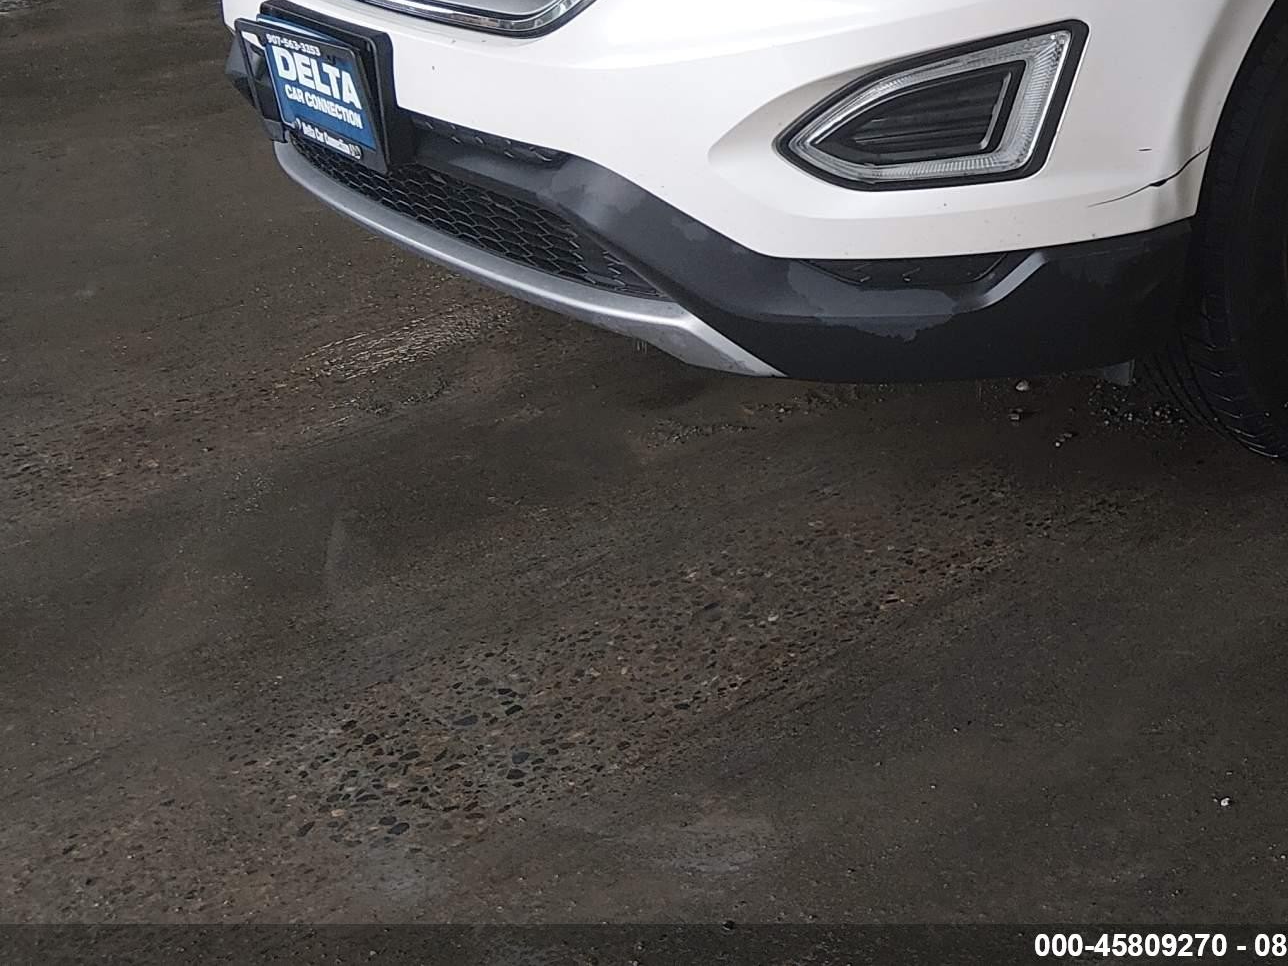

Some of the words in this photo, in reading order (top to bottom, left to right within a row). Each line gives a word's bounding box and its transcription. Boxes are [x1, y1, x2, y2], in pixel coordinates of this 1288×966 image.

[272, 46, 362, 110] DELTA
[284, 84, 306, 105] CAR
[305, 91, 363, 130] CONNECTION
